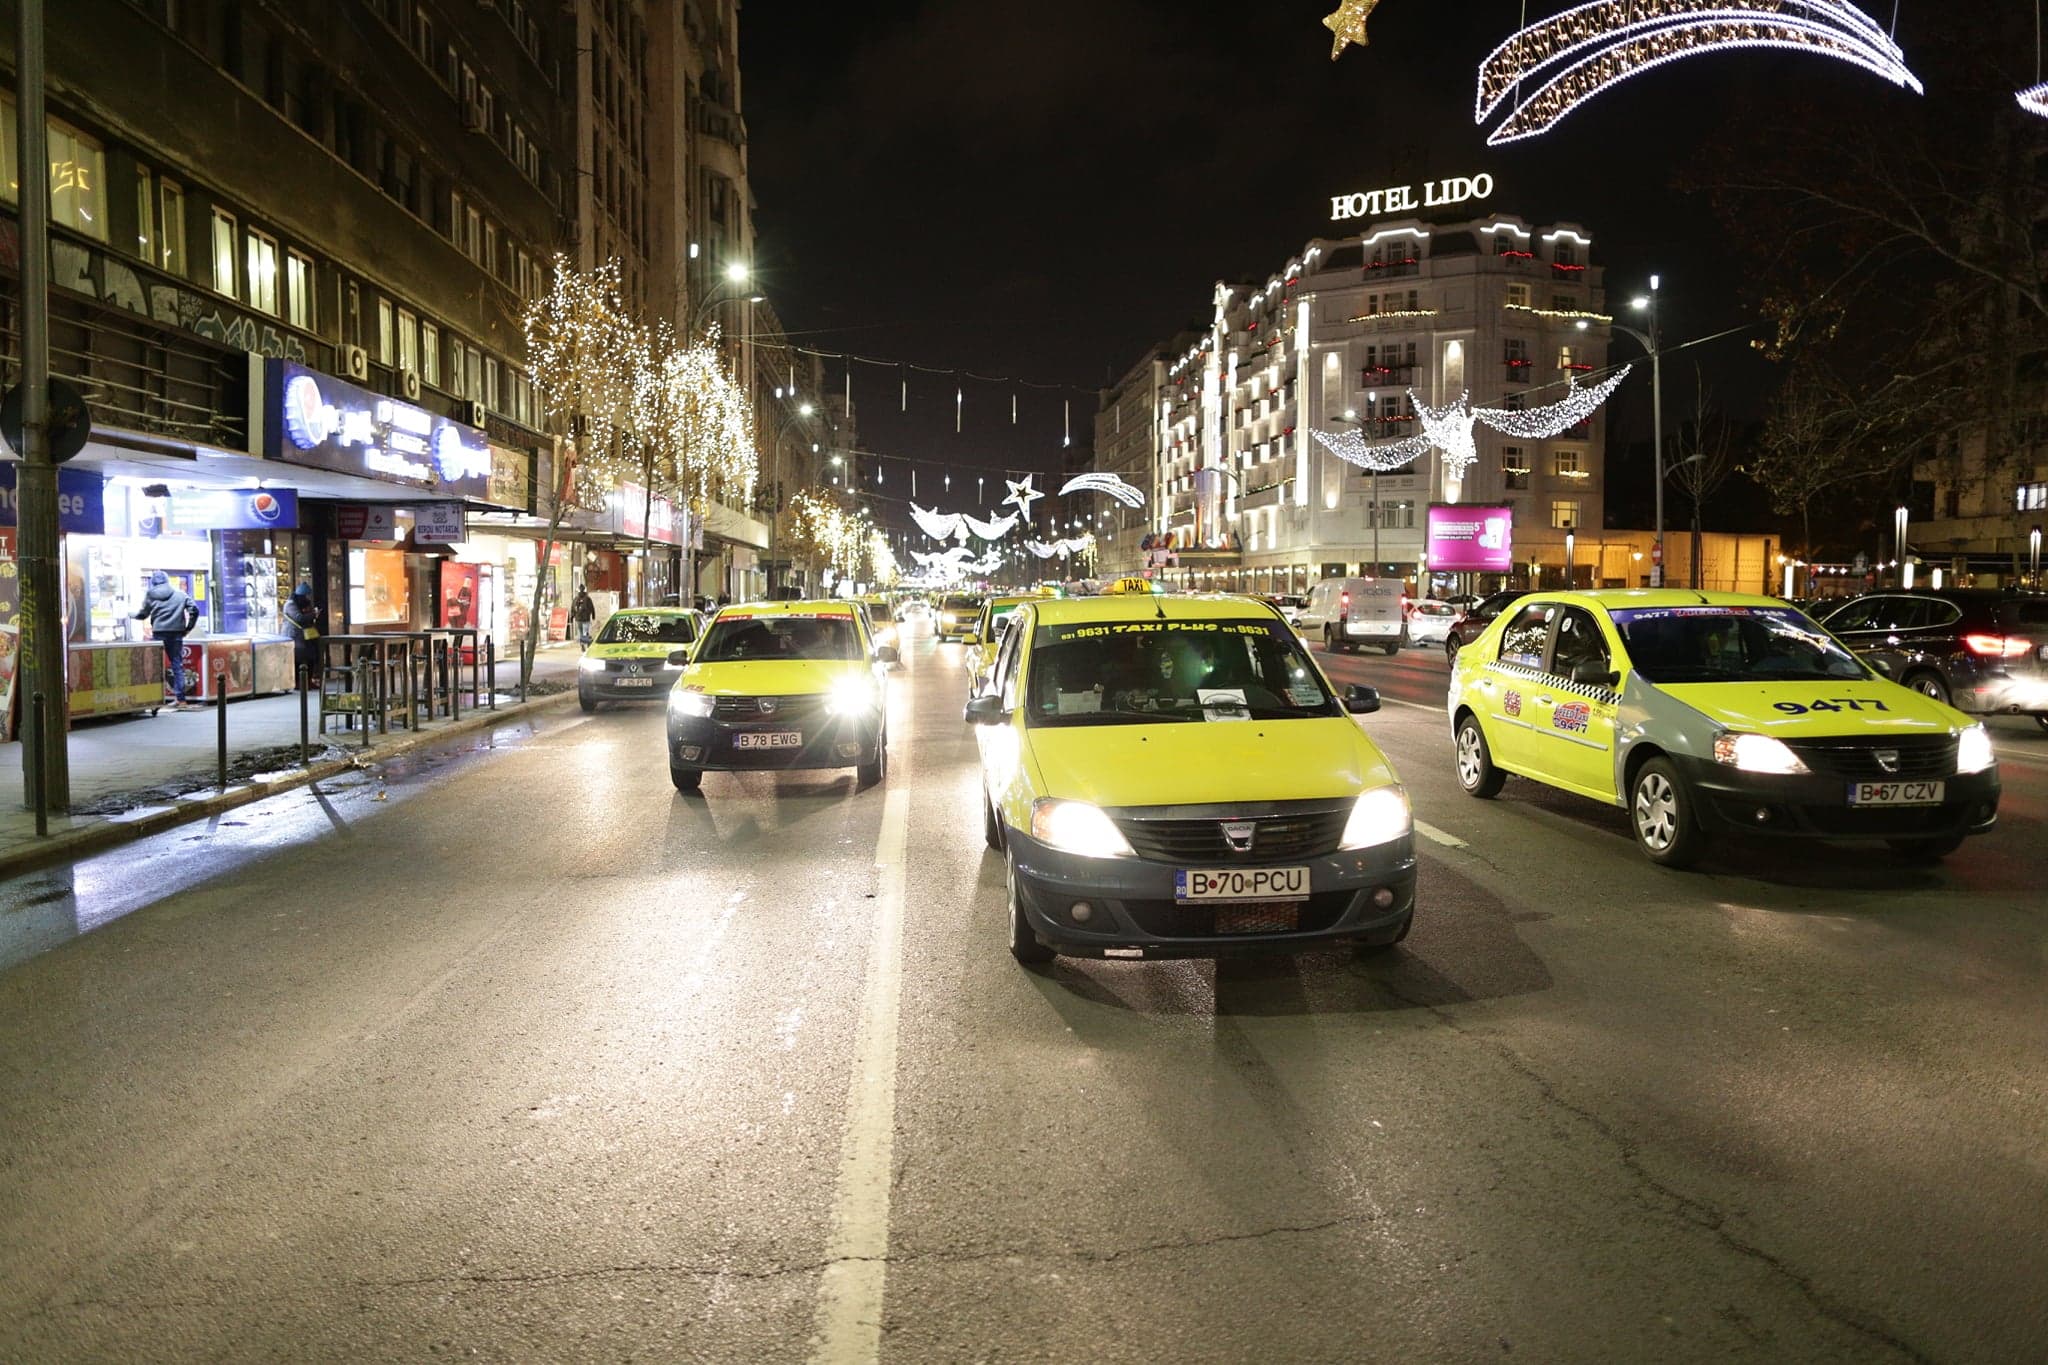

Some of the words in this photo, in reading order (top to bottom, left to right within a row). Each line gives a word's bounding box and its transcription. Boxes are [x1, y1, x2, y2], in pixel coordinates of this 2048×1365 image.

[1330, 185, 1418, 220] HOTEL
[1423, 173, 1493, 207] LIDO
[1077, 626, 1109, 637] 9631
[1112, 624, 1162, 633] TAXI
[1237, 625, 1269, 635] 9631
[1773, 699, 1890, 715] 9477
[1560, 720, 1588, 734] 9477
[740, 735, 749, 746] B
[753, 735, 767, 745] 78
[771, 734, 798, 745] EWG
[1861, 786, 1874, 801] B
[1880, 784, 1899, 801] 67
[1903, 783, 1938, 800] CZV
[1192, 873, 1208, 895] B
[1217, 873, 1245, 894] 70
[1254, 870, 1302, 893] PCU
